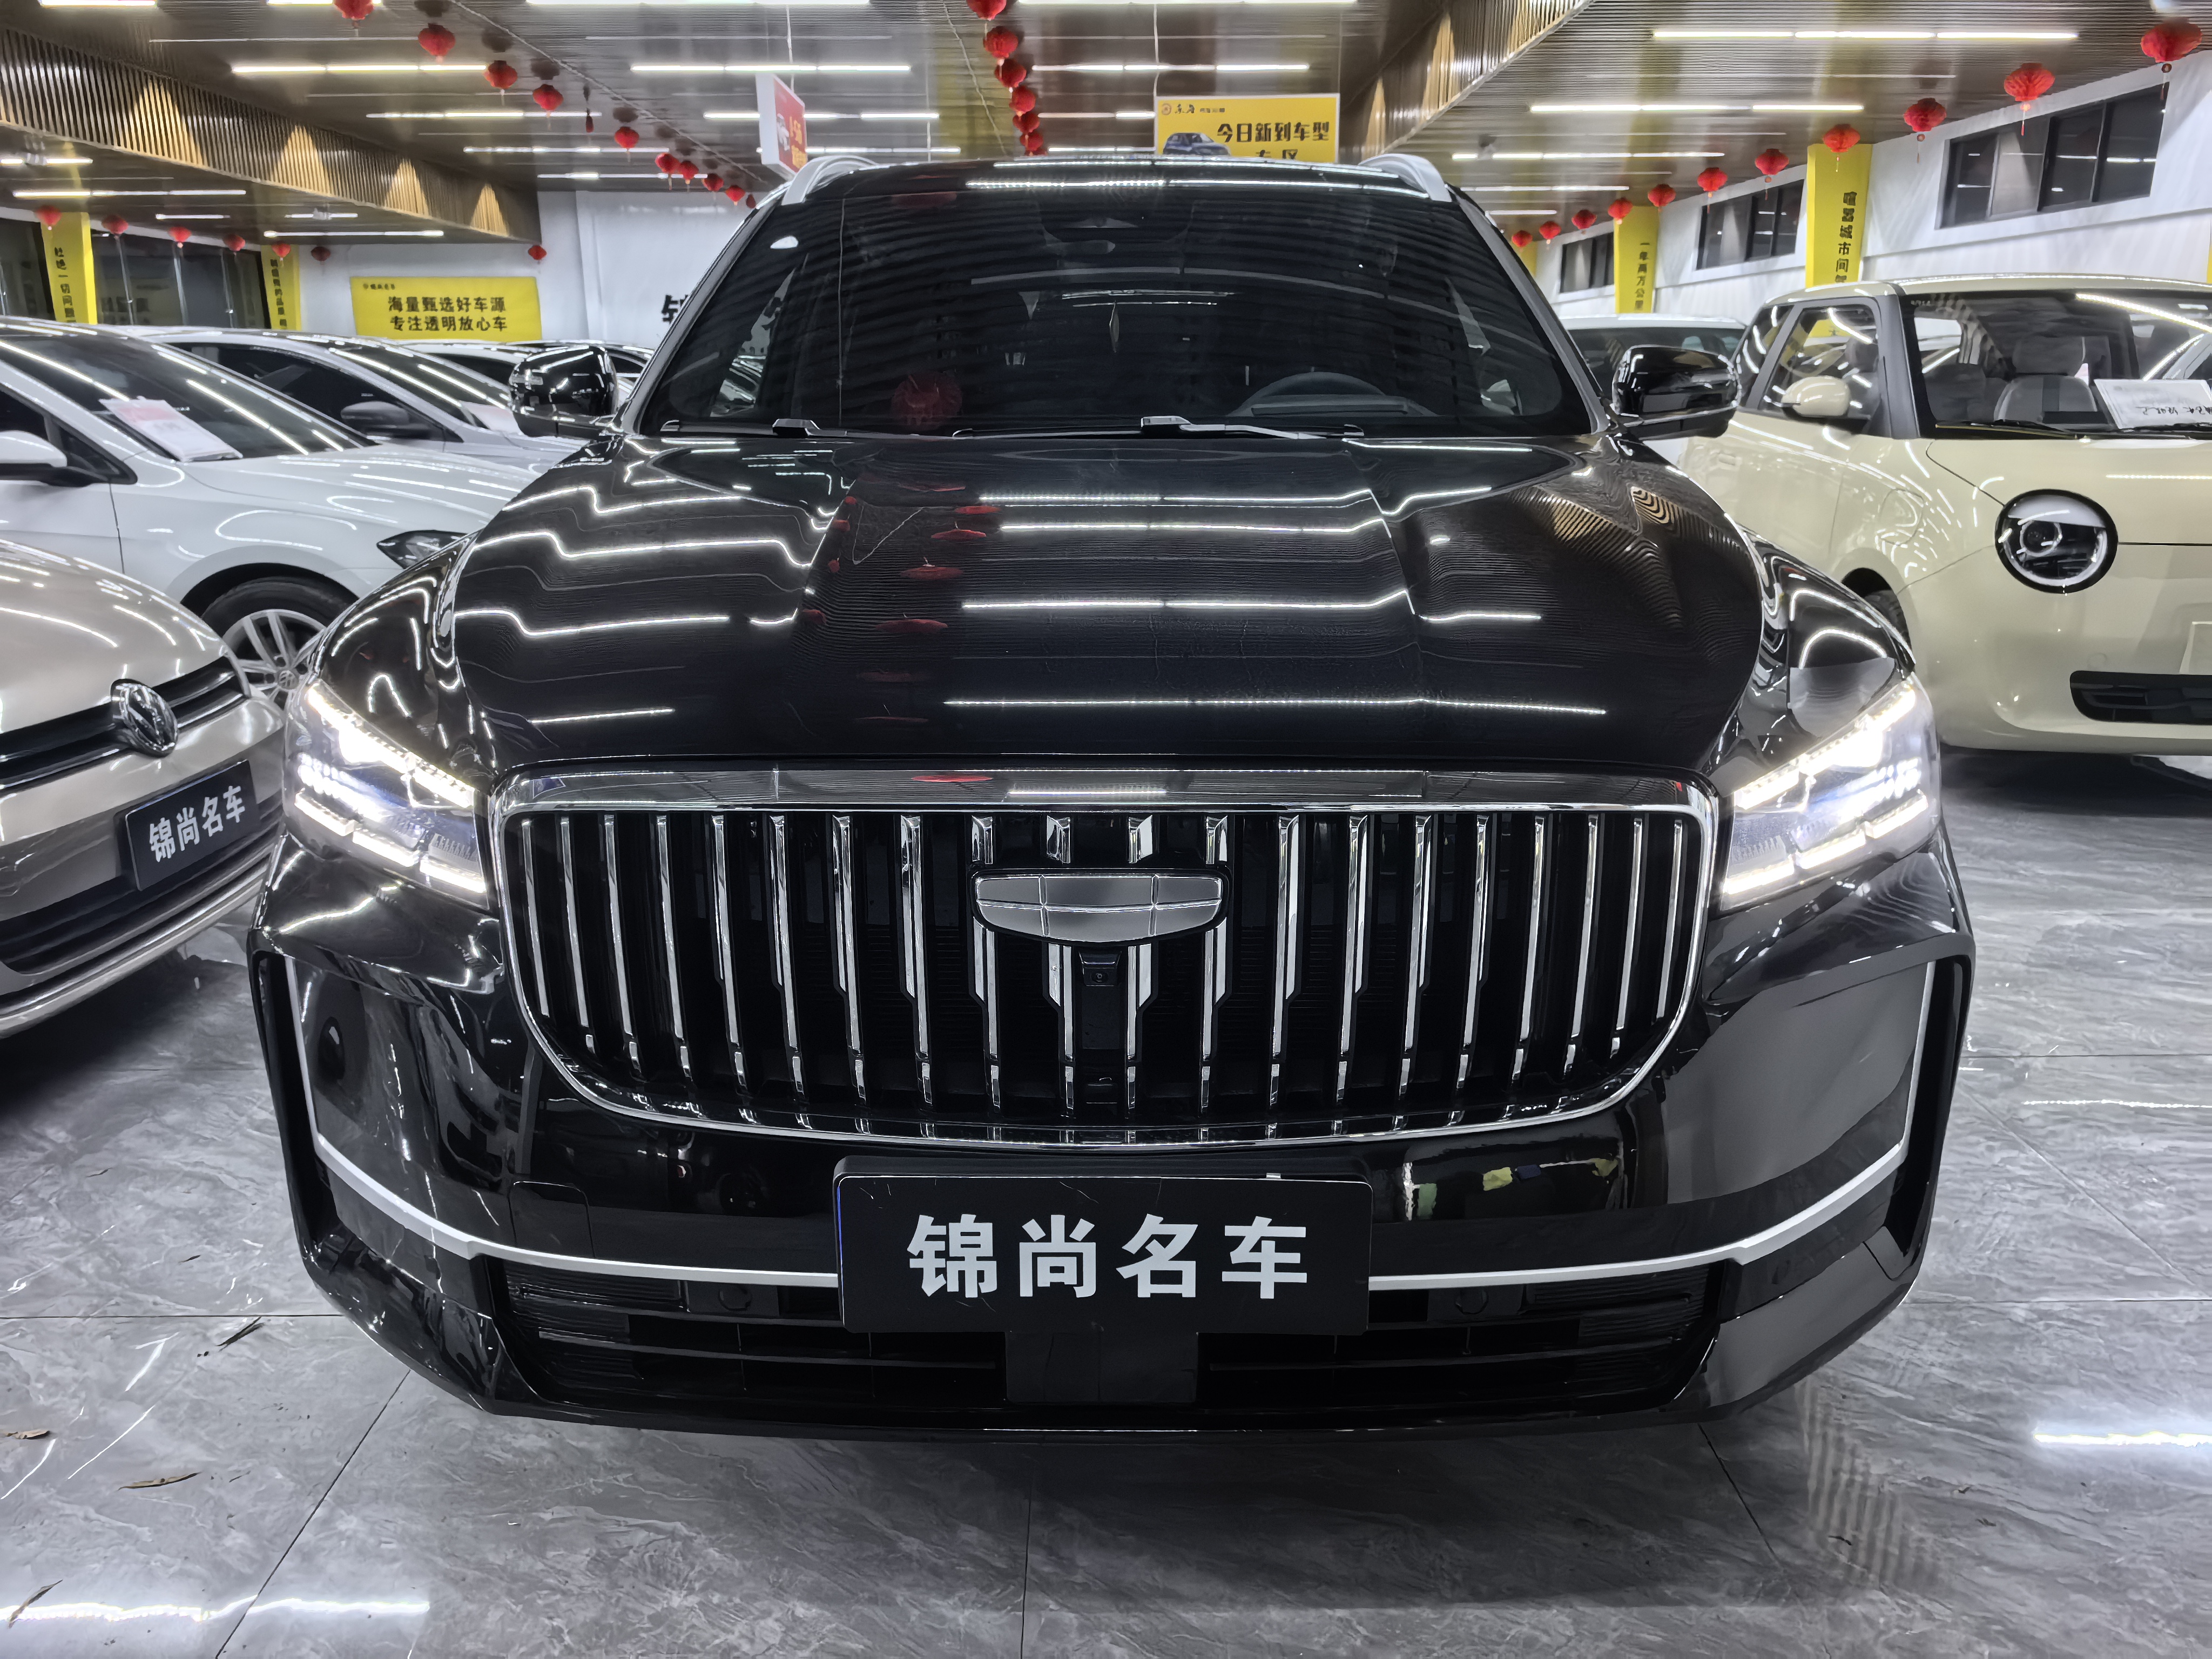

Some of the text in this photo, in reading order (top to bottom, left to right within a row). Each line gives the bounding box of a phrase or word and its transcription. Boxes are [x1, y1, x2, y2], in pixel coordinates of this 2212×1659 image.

[1217, 122, 1330, 143] 今日新到车型
[388, 296, 506, 312] 海量甄选好车源
[390, 315, 508, 332] 专注透明放心车
[149, 785, 246, 862] 锦尚名车
[907, 1213, 1307, 1299] 锦尚名车
